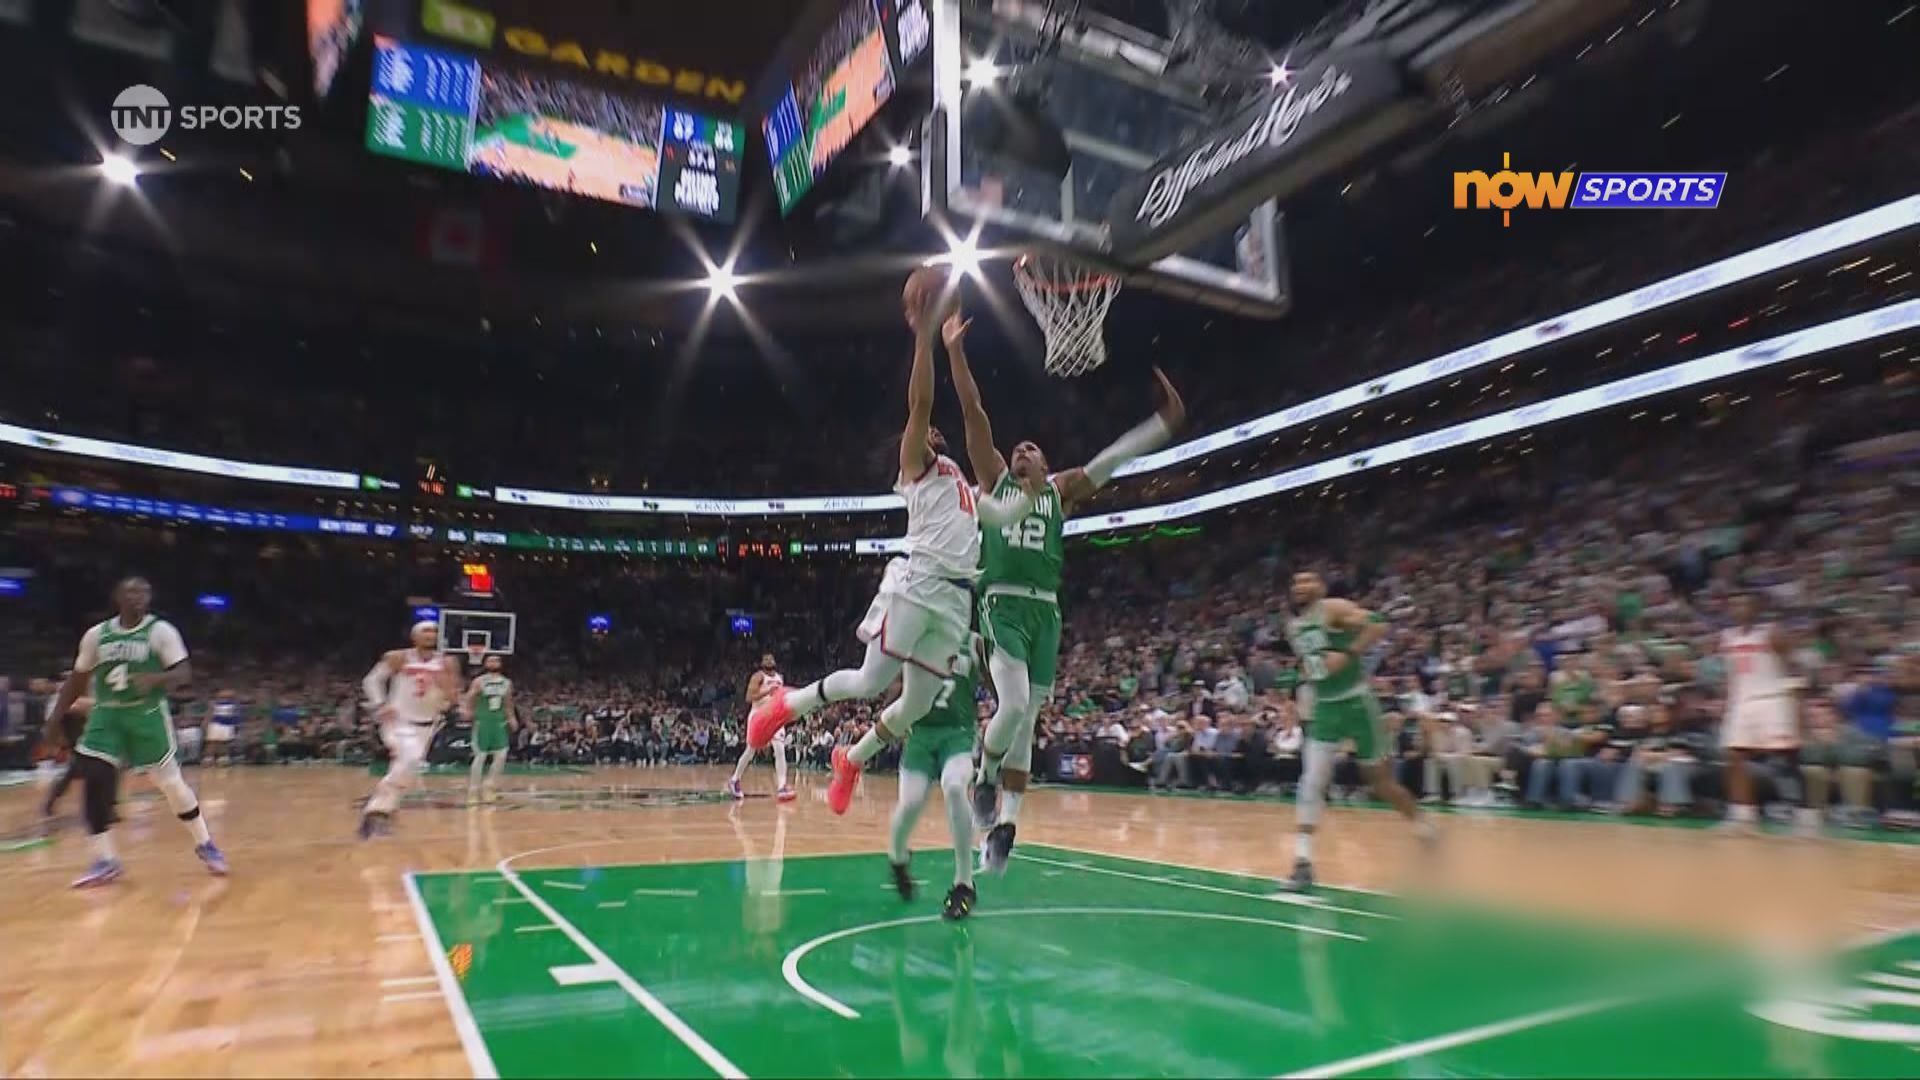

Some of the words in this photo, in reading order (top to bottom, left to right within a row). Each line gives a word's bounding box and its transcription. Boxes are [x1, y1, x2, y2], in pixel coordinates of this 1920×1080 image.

[503, 26, 746, 103] GARDEN
[1001, 516, 1046, 551] 42
[104, 663, 129, 691] 4
